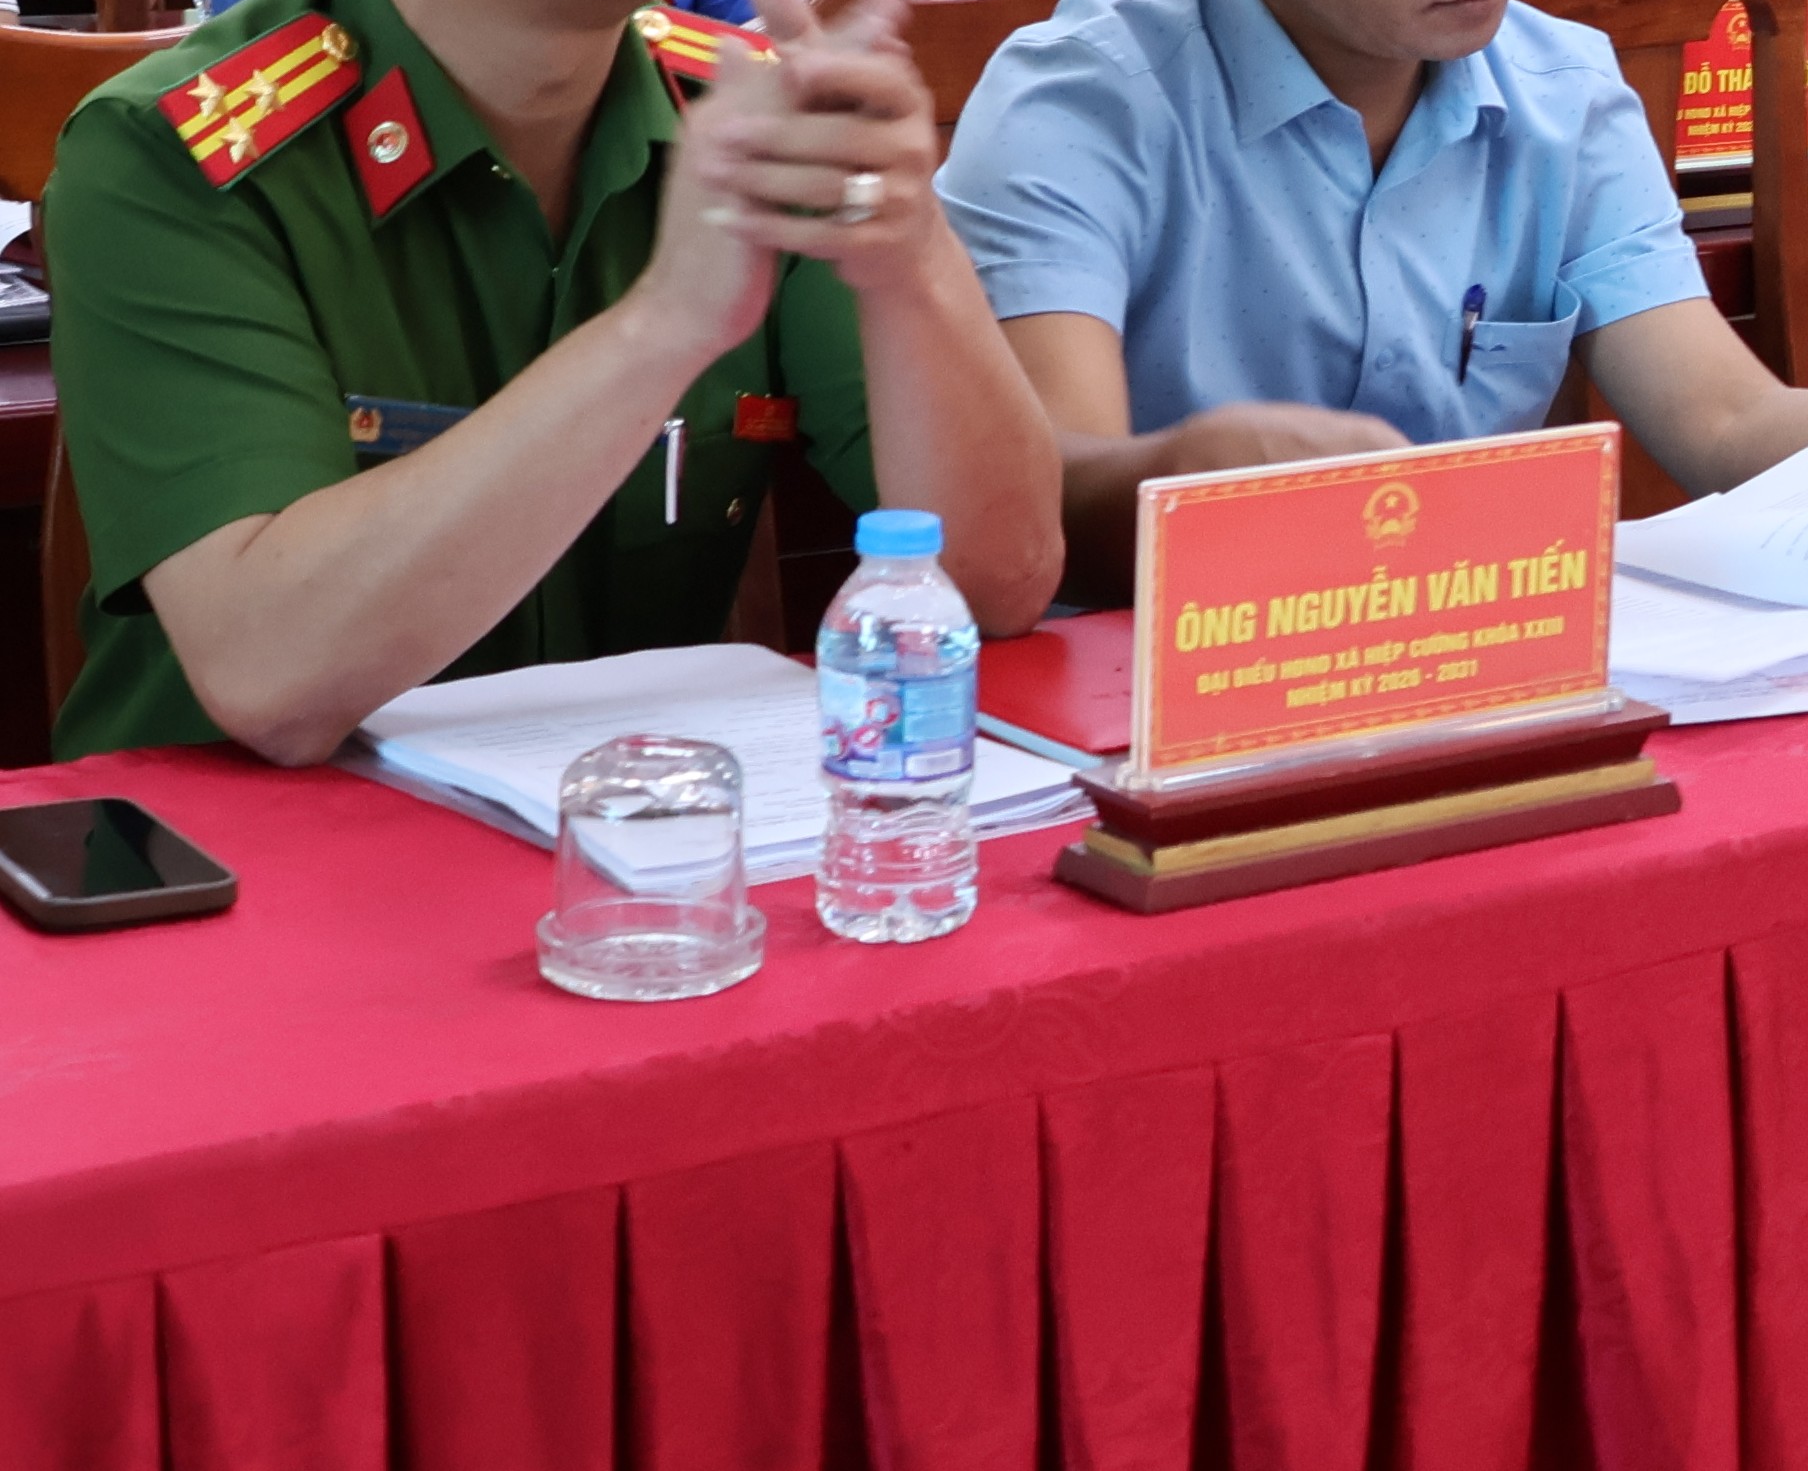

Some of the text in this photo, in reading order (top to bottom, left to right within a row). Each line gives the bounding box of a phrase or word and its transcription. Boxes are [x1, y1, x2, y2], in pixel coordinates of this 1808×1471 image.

[1175, 539, 1587, 652] ÔNG NGUYỄN VĂN TIẾN
